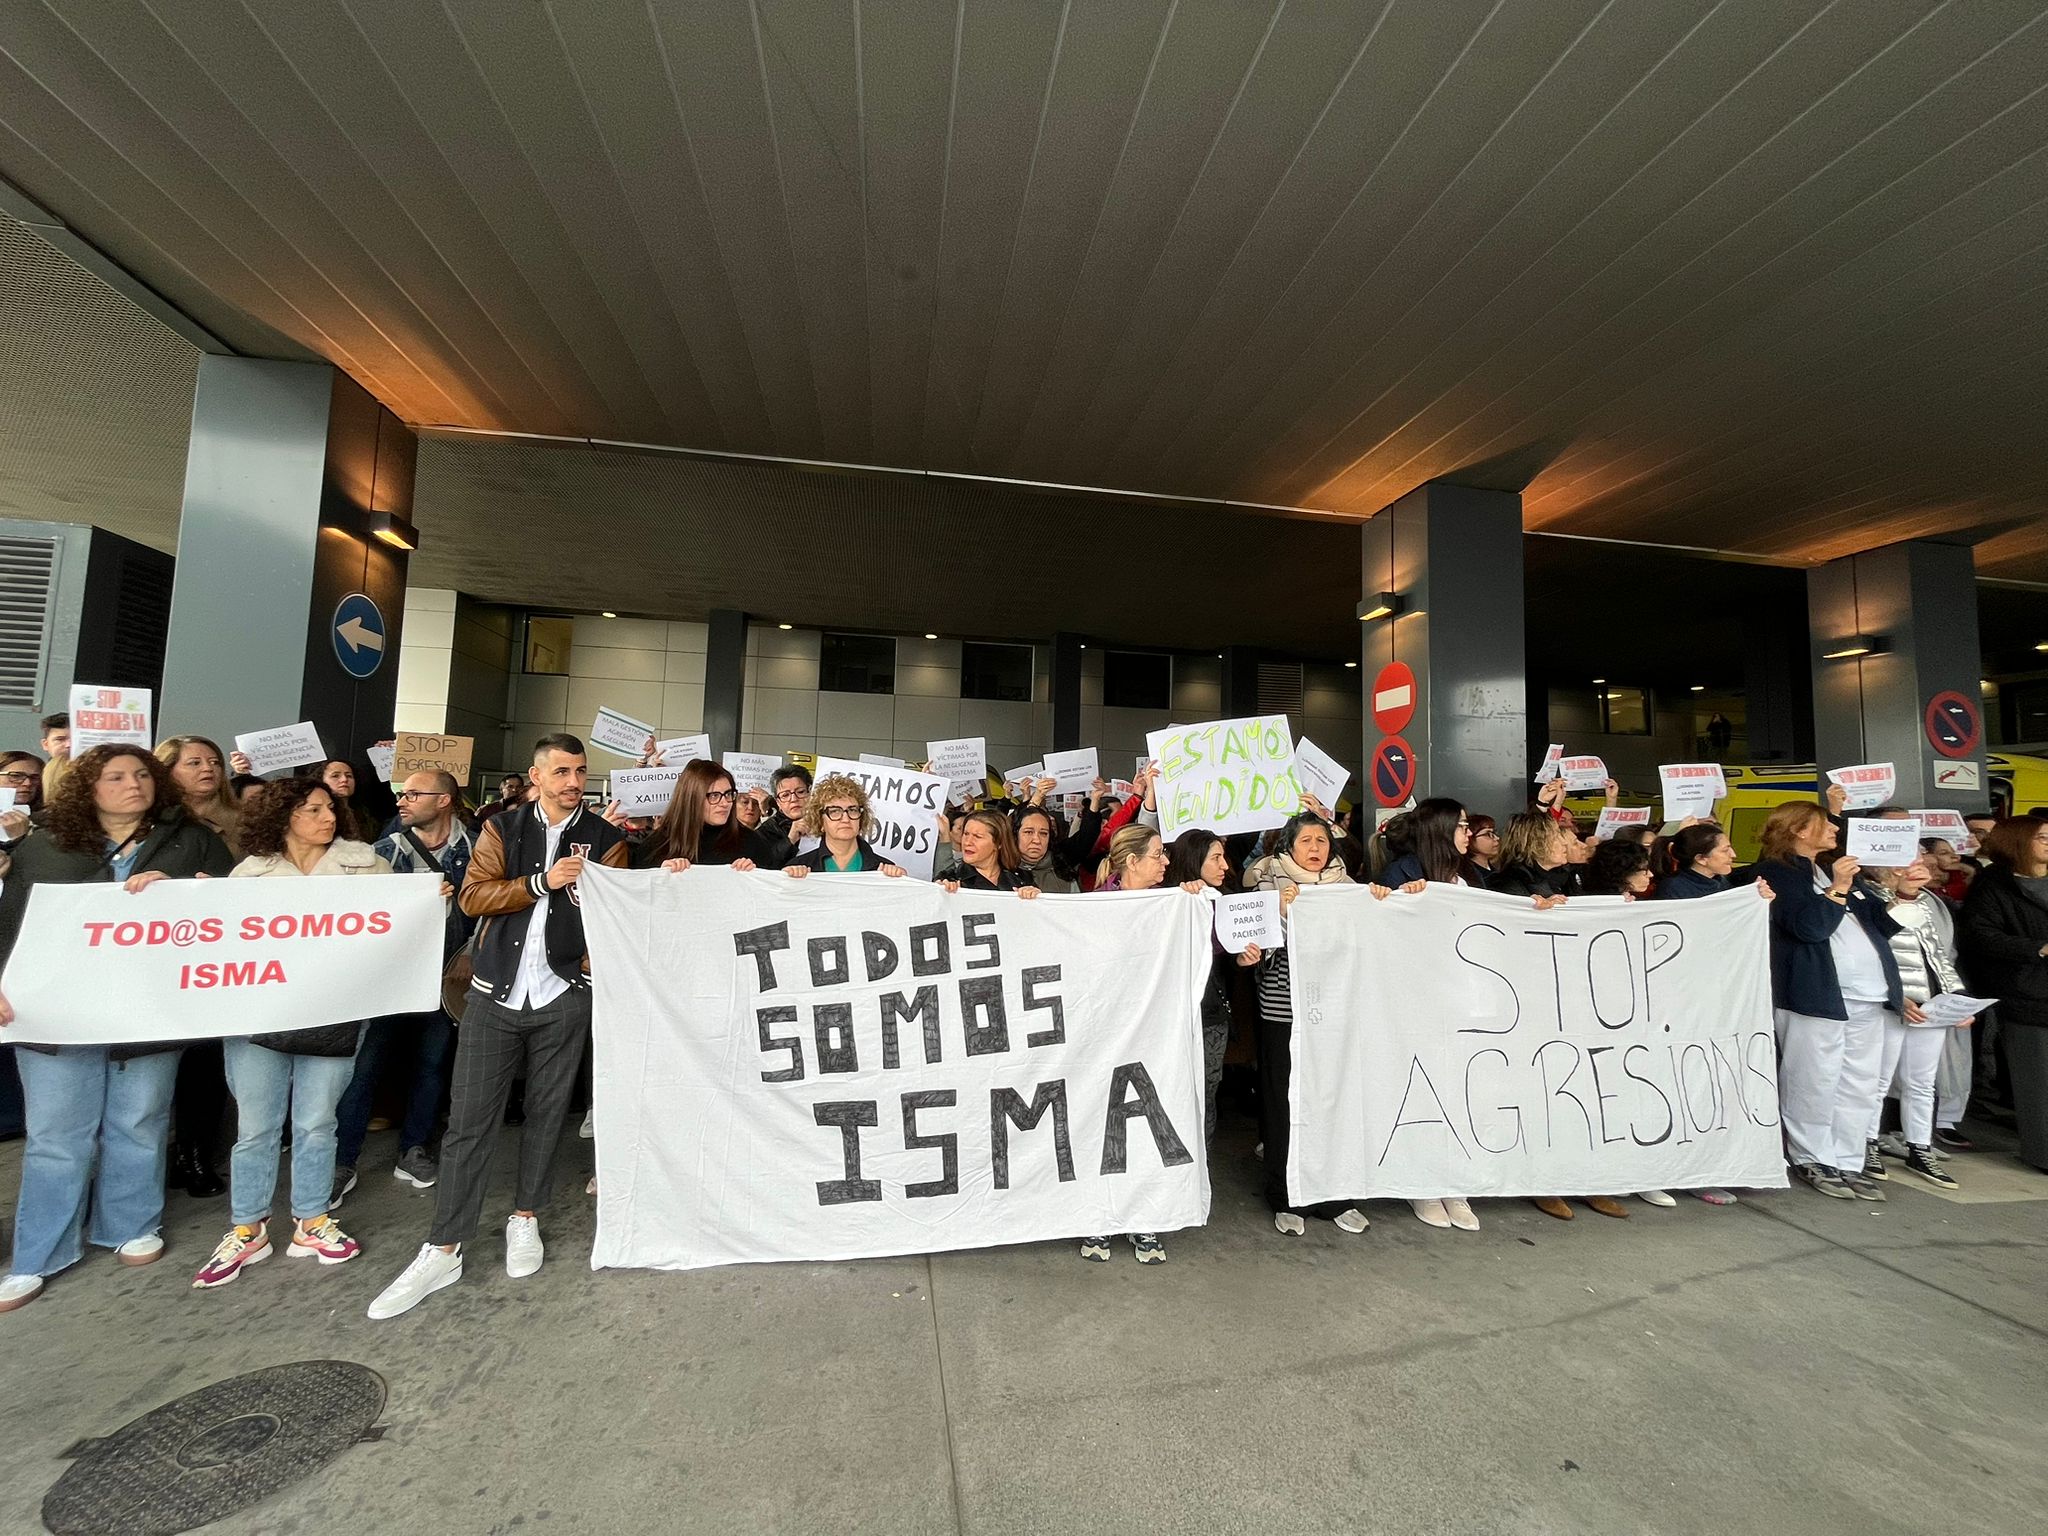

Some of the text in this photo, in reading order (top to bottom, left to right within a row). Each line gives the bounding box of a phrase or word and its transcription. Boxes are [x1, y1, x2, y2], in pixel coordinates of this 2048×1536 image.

[97, 690, 121, 708] STOP
[602, 717, 619, 727] MALA
[259, 735, 272, 744] NO
[404, 736, 457, 753] STOP
[602, 734, 636, 750] ASEGURADA
[1160, 719, 1290, 783] ESTAMOS
[397, 757, 470, 775] AGRESIONS
[944, 761, 981, 769] NEGLIGENCIA
[951, 769, 976, 777] SISTEMA
[1858, 824, 1915, 833] SEGURIDADE
[1229, 900, 1264, 911] DIGNIDAD
[1234, 914, 1263, 925] PARA OS
[83, 910, 392, 947] TOD@S SOMOS
[1232, 927, 1266, 939] PACIENTES
[733, 912, 1000, 993] TODOS
[179, 959, 288, 989] ISMA
[756, 964, 1066, 1082] SOMOS
[1378, 1032, 1779, 1167] AGRESIONS
[813, 1061, 1194, 1205] ISMA
